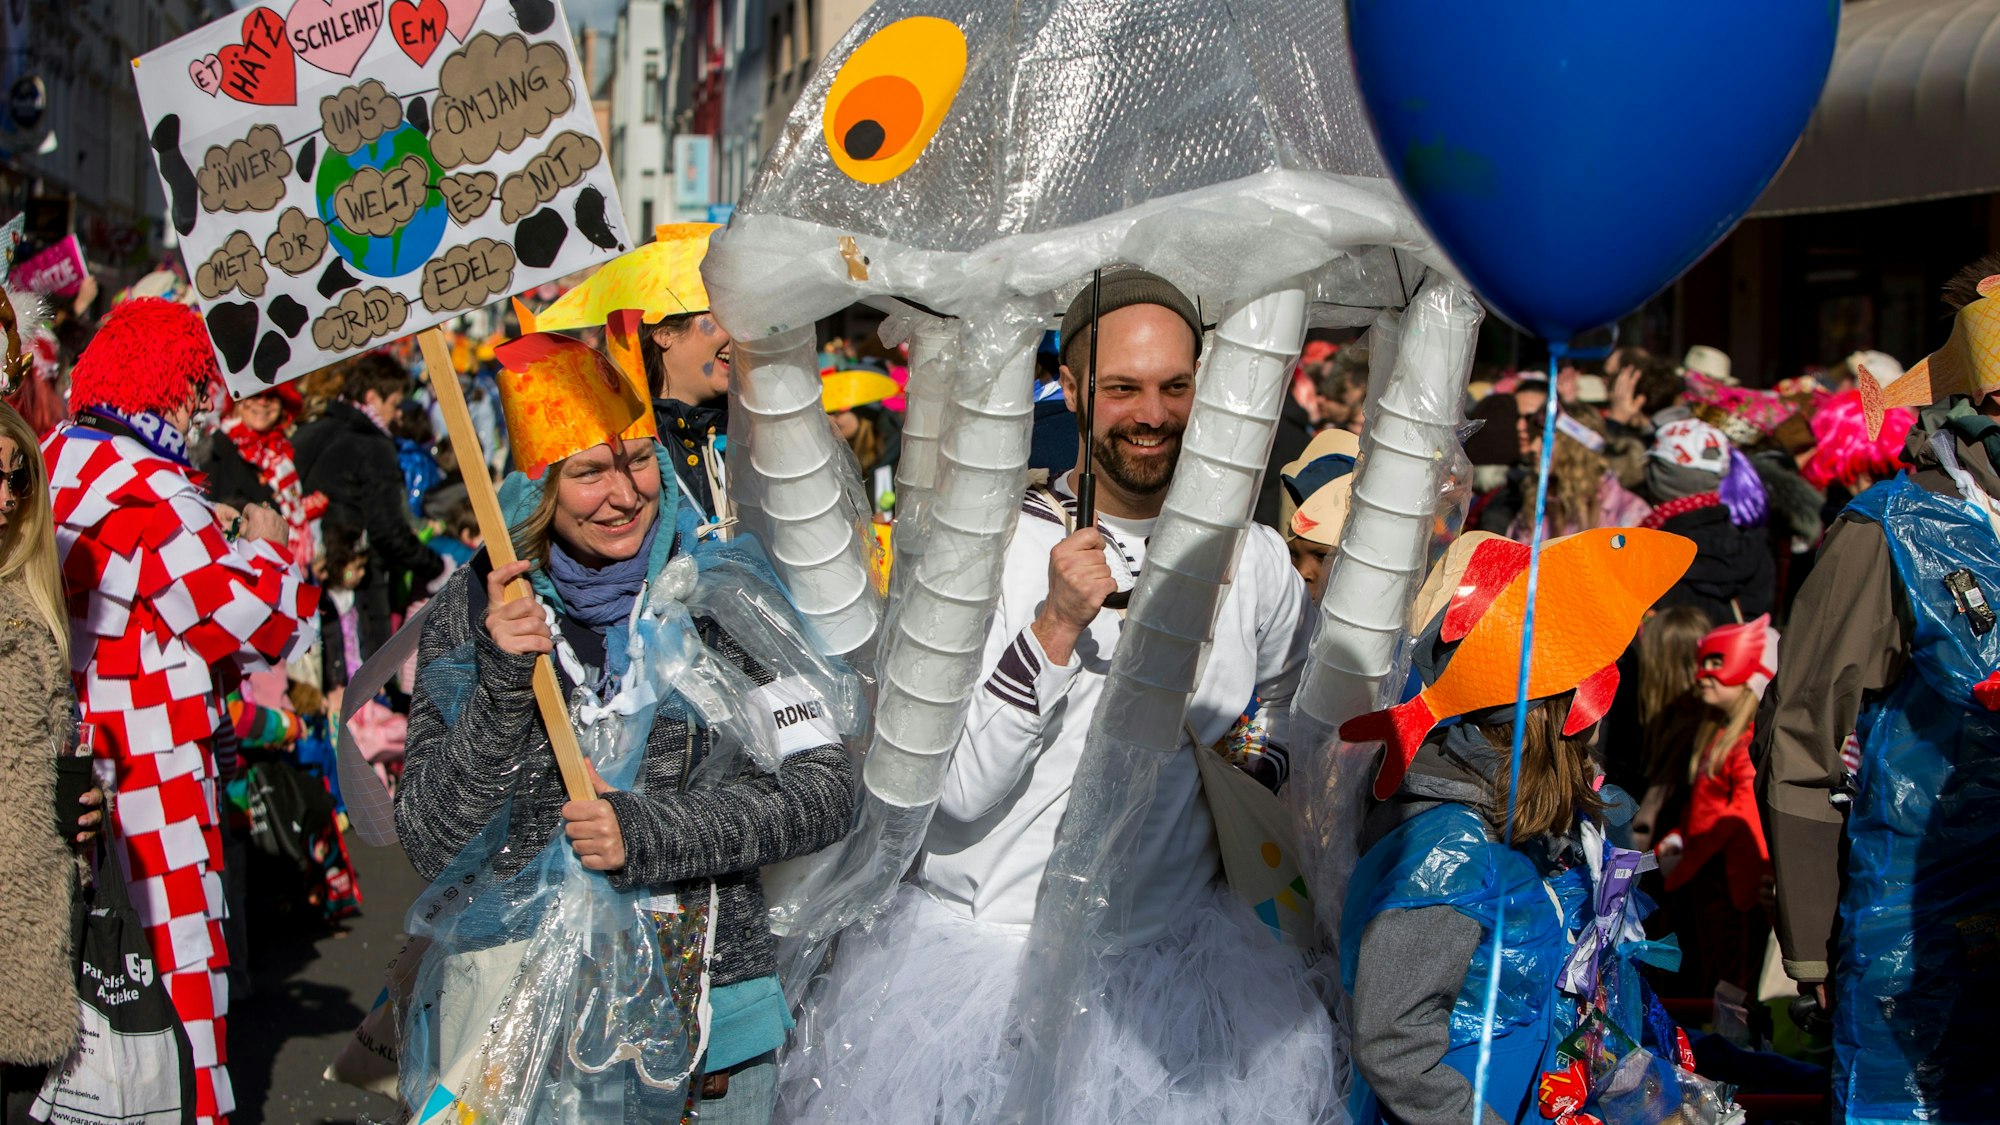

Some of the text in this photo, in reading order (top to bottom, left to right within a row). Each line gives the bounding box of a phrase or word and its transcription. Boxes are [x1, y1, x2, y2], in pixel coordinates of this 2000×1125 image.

[195, 1, 440, 99] ET HÄTZ SCHLEIHT EM
[331, 103, 378, 135] UNS
[443, 65, 550, 135] ÖMJANG
[212, 252, 251, 286] MET
[345, 174, 412, 223] WELT
[451, 184, 483, 216] ES
[528, 146, 572, 190] NIT
[334, 256, 498, 337] JRAD EDEL
